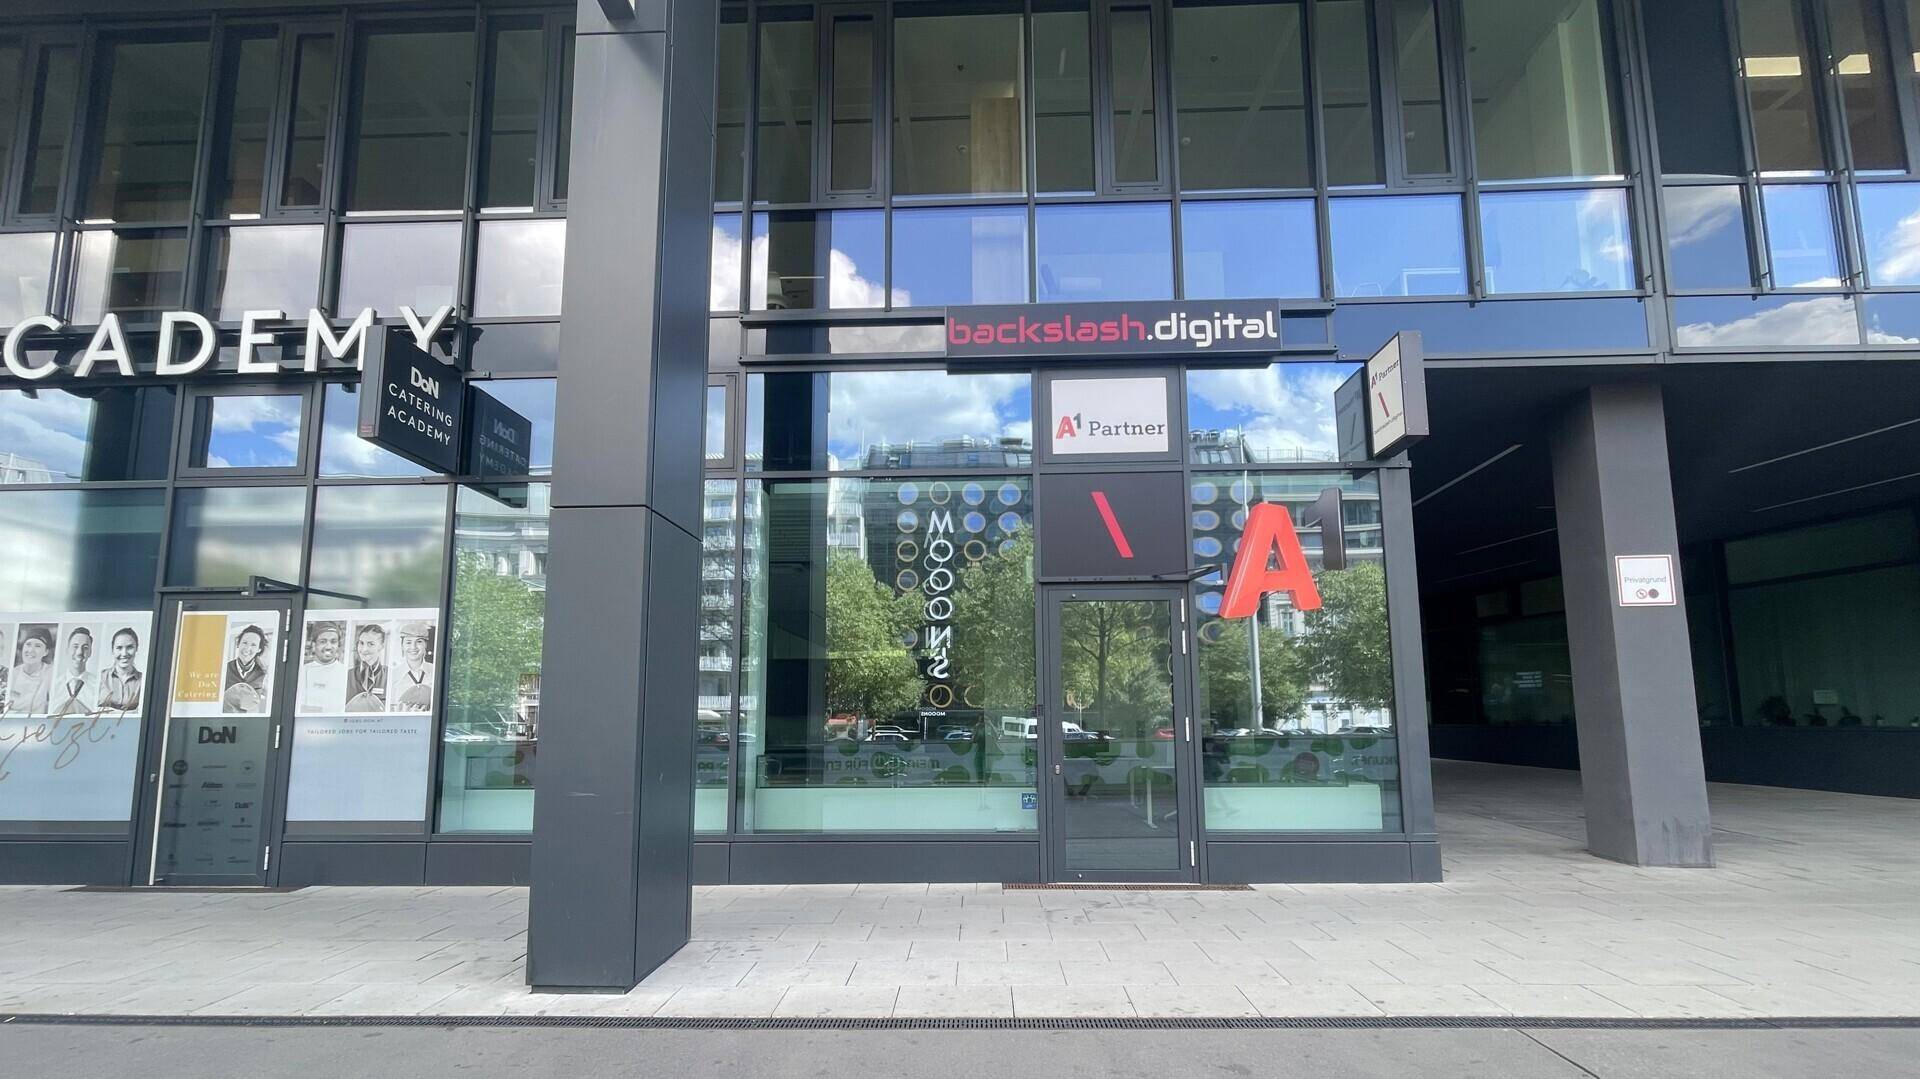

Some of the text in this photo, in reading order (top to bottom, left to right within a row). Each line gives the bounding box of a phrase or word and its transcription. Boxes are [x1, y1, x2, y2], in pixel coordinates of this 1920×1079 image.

[949, 310, 1278, 348] backslash.digital
[410, 366, 440, 400] DoN
[1378, 359, 1399, 382] Partner
[388, 382, 453, 427] CATERING
[387, 405, 451, 446] ACADEMY
[1056, 413, 1165, 440] A1 Partner
[1219, 488, 1346, 619] A1
[1624, 576, 1667, 584] Privatgrund
[177, 690, 217, 698] Catering
[198, 726, 237, 744] DoN
